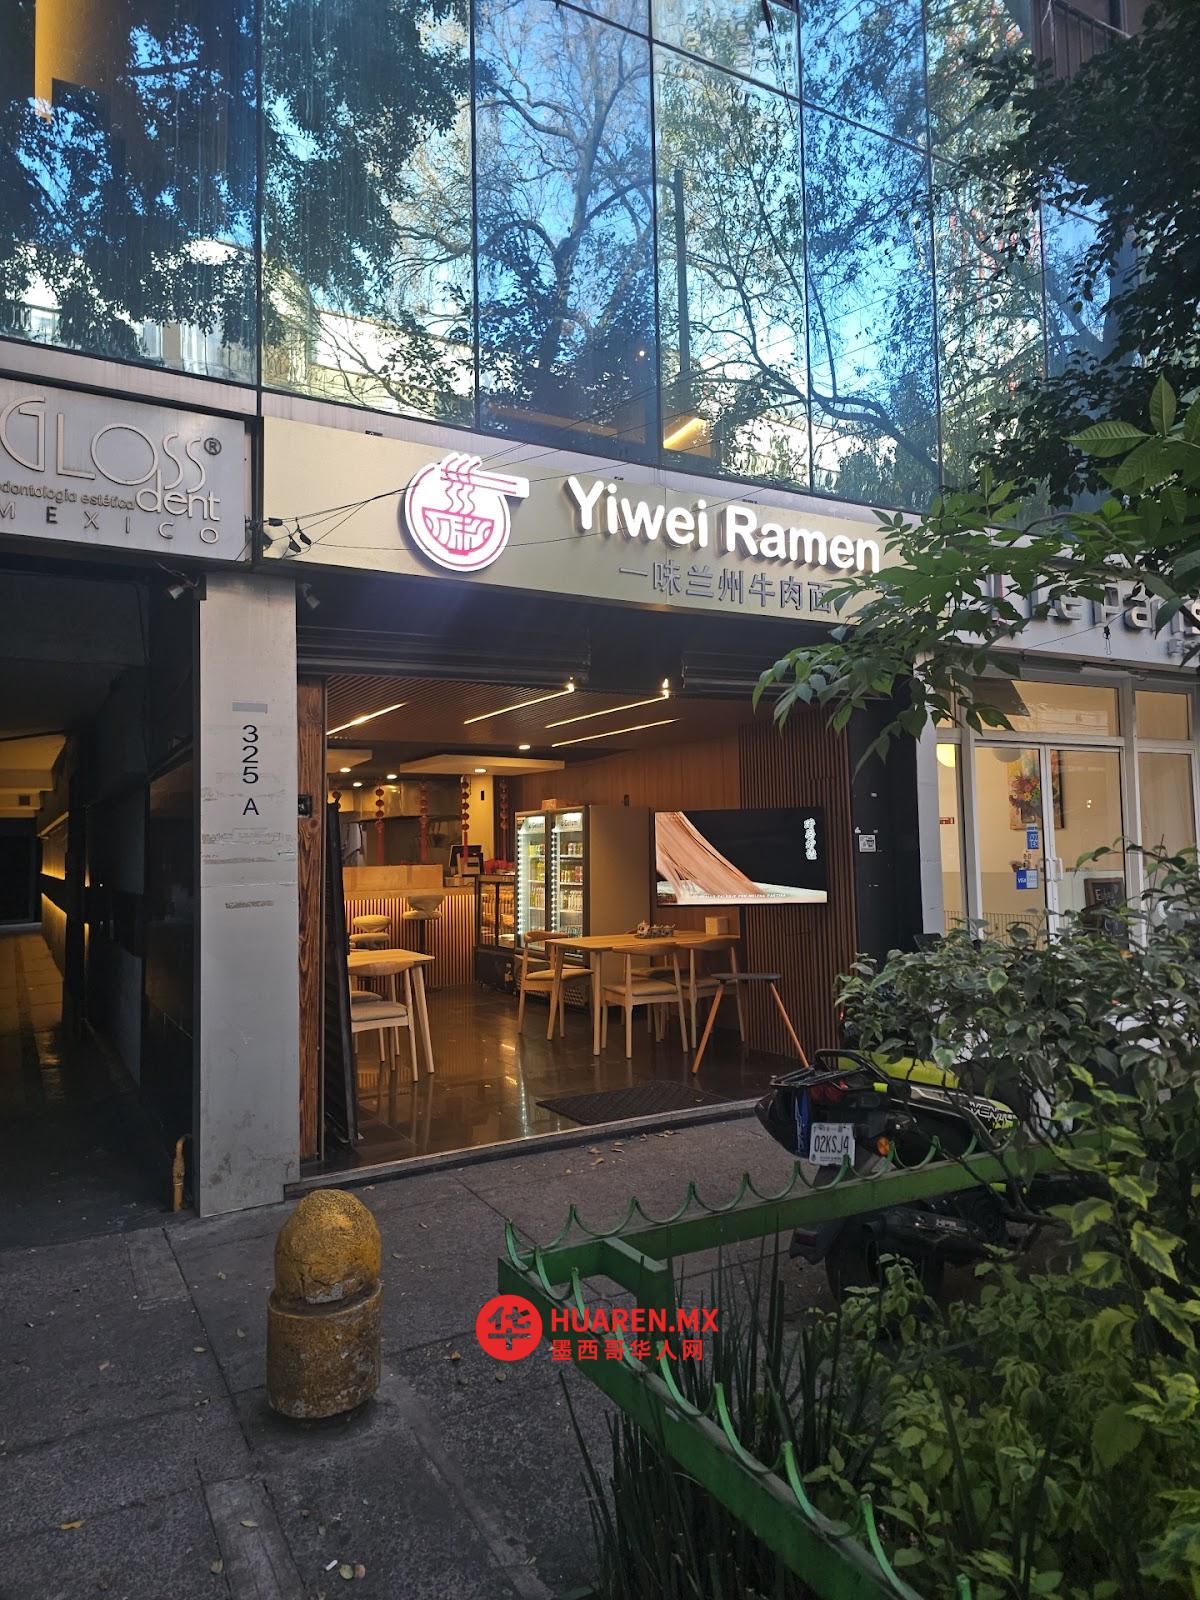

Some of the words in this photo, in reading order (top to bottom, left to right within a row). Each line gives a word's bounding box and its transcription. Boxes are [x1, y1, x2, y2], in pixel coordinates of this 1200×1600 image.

[135, 467, 220, 522] dent
[567, 475, 709, 548] Yiwei
[725, 504, 880, 573] Ramen
[618, 559, 833, 614] 一味兰州牛肉面
[242, 797, 260, 815] A
